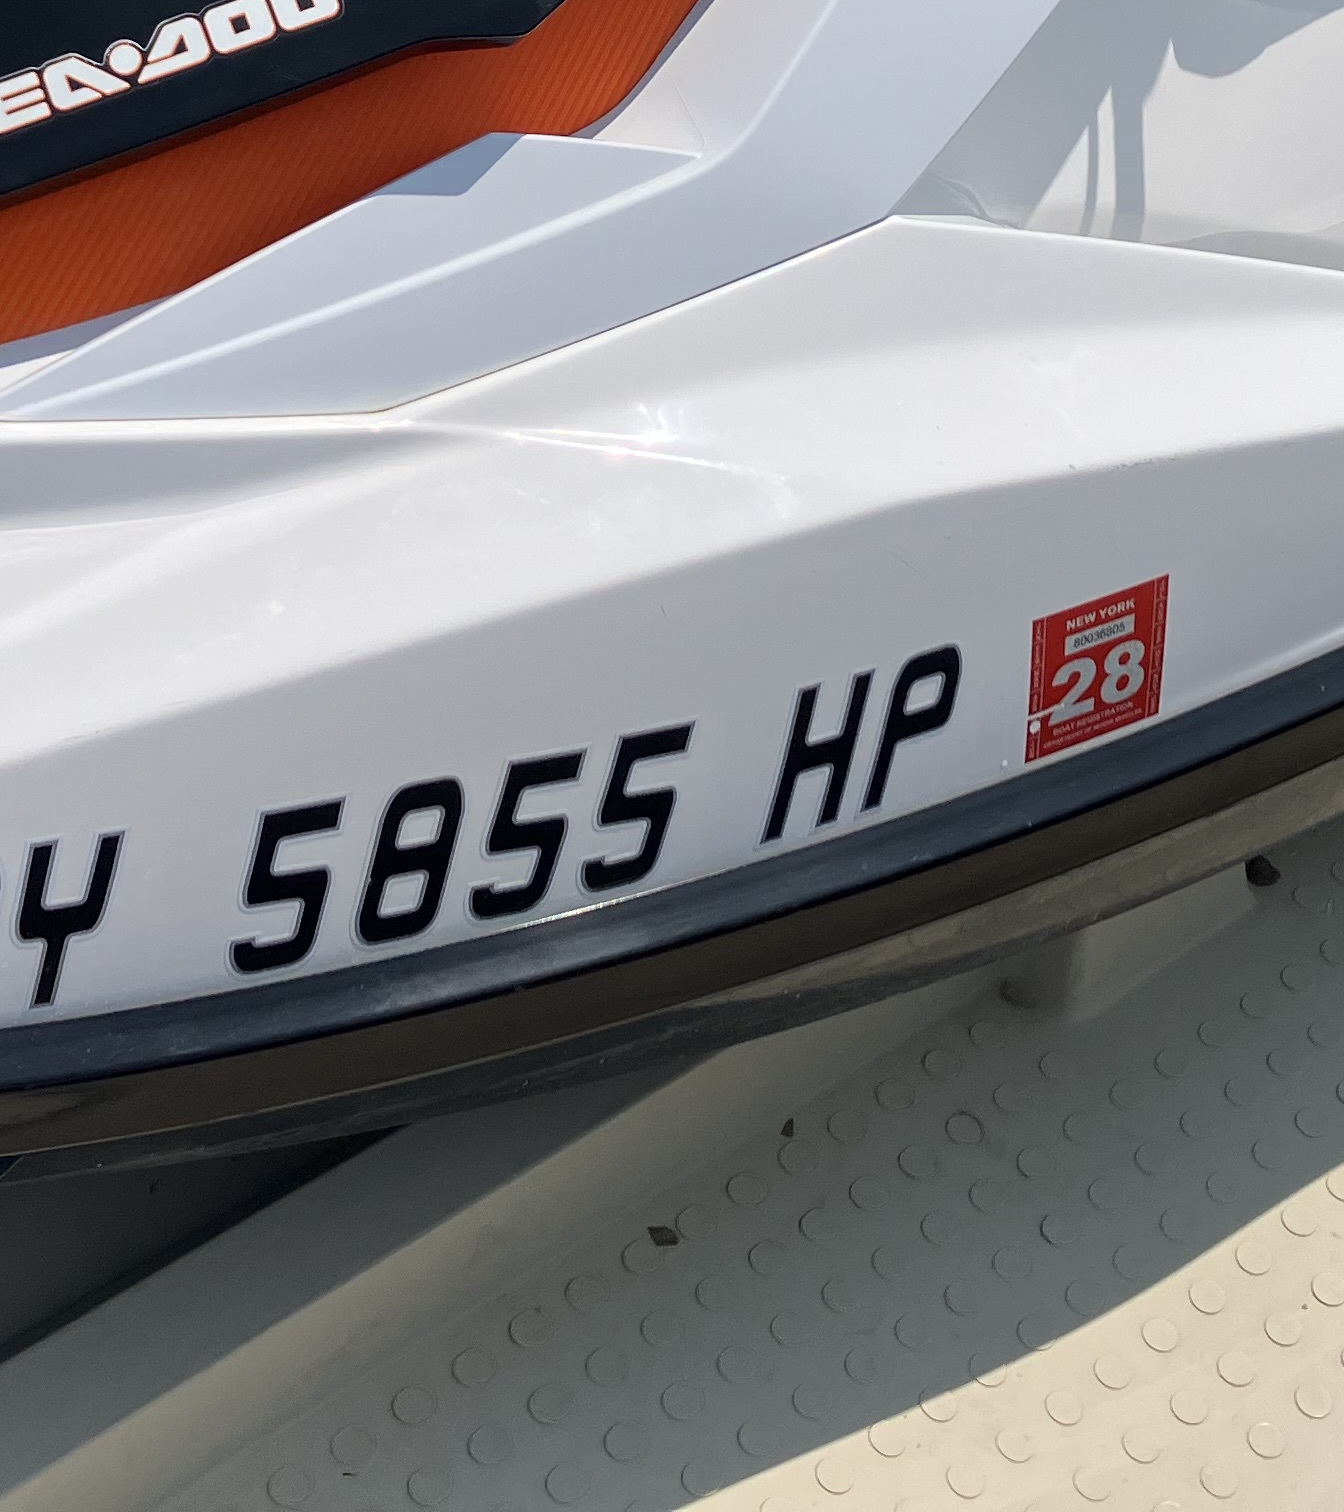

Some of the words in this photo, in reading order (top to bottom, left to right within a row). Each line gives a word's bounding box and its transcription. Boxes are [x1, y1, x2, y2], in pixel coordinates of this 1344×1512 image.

[1066, 611, 1097, 632] NEW
[1099, 597, 1136, 620] YORK
[1047, 639, 1146, 727] 28
[228, 719, 697, 975] 5855
[758, 643, 962, 844] HP
